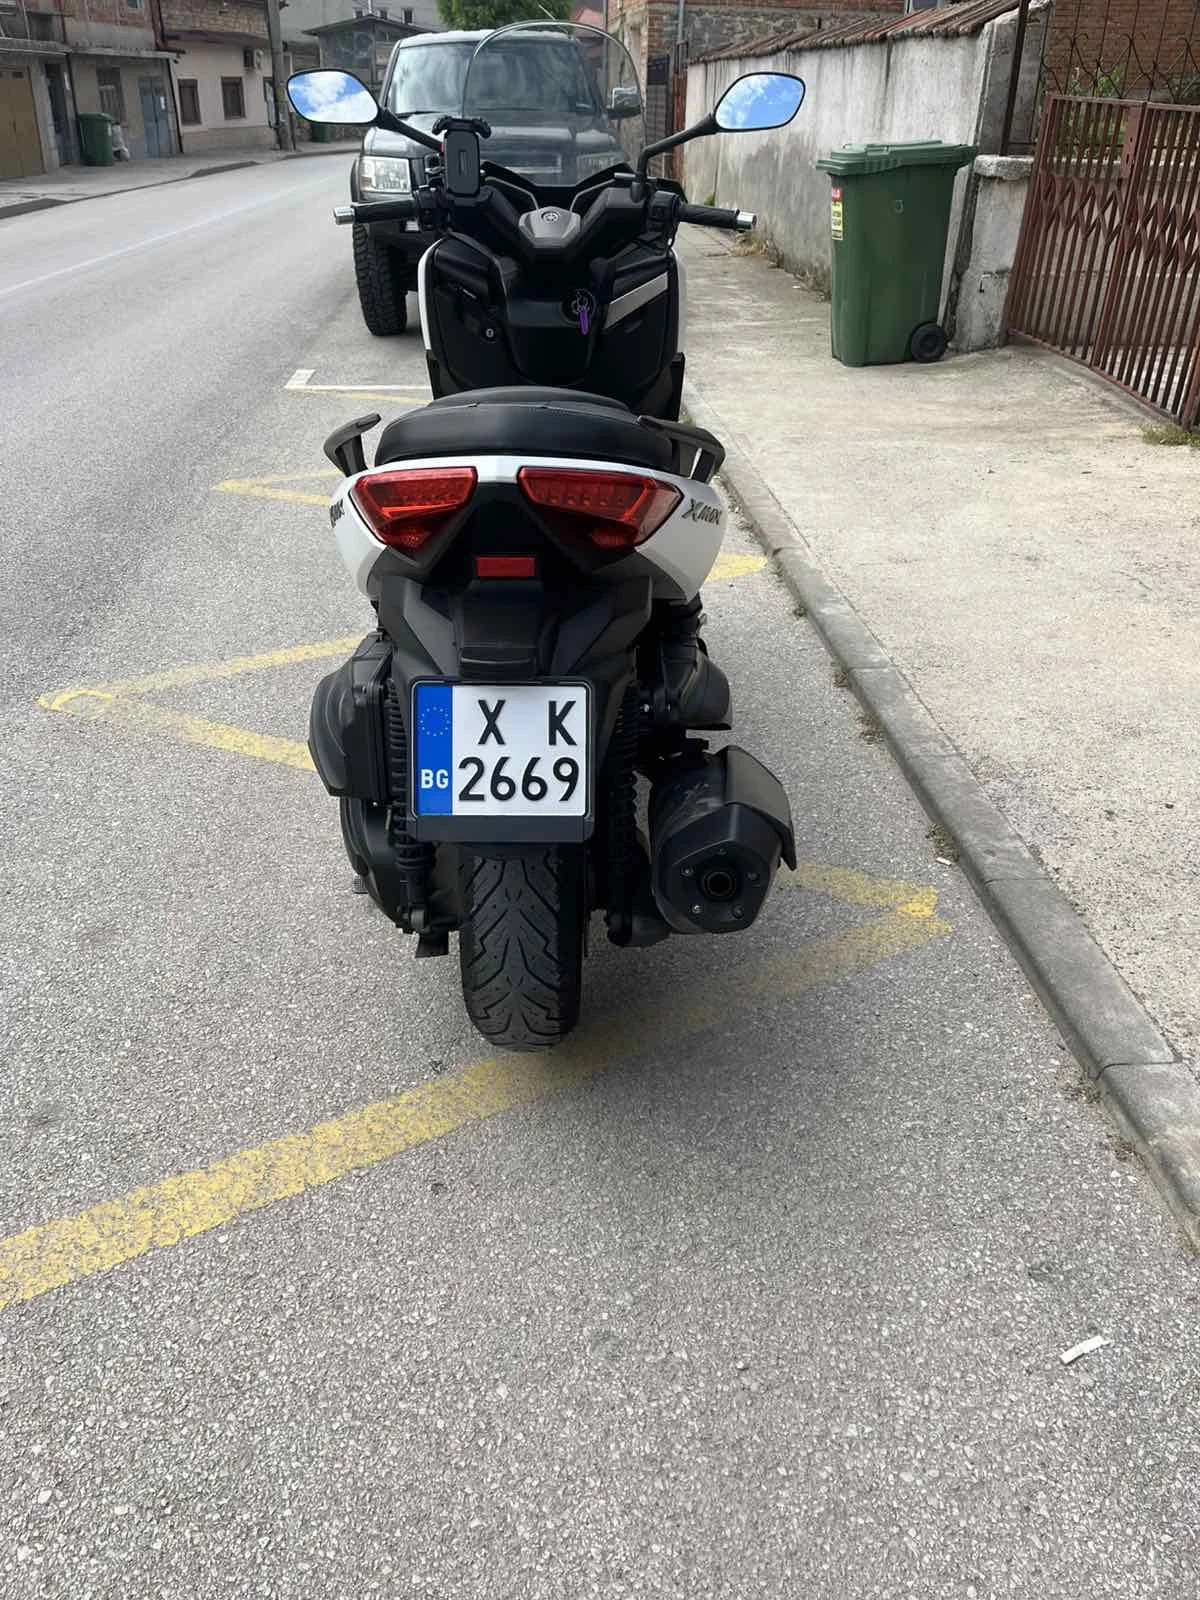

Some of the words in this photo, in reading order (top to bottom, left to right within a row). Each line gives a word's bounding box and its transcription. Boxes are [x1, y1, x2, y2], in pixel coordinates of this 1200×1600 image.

[478, 699, 506, 745] X
[548, 700, 577, 746] K
[420, 769, 449, 789] BG
[458, 756, 579, 801] 2669
